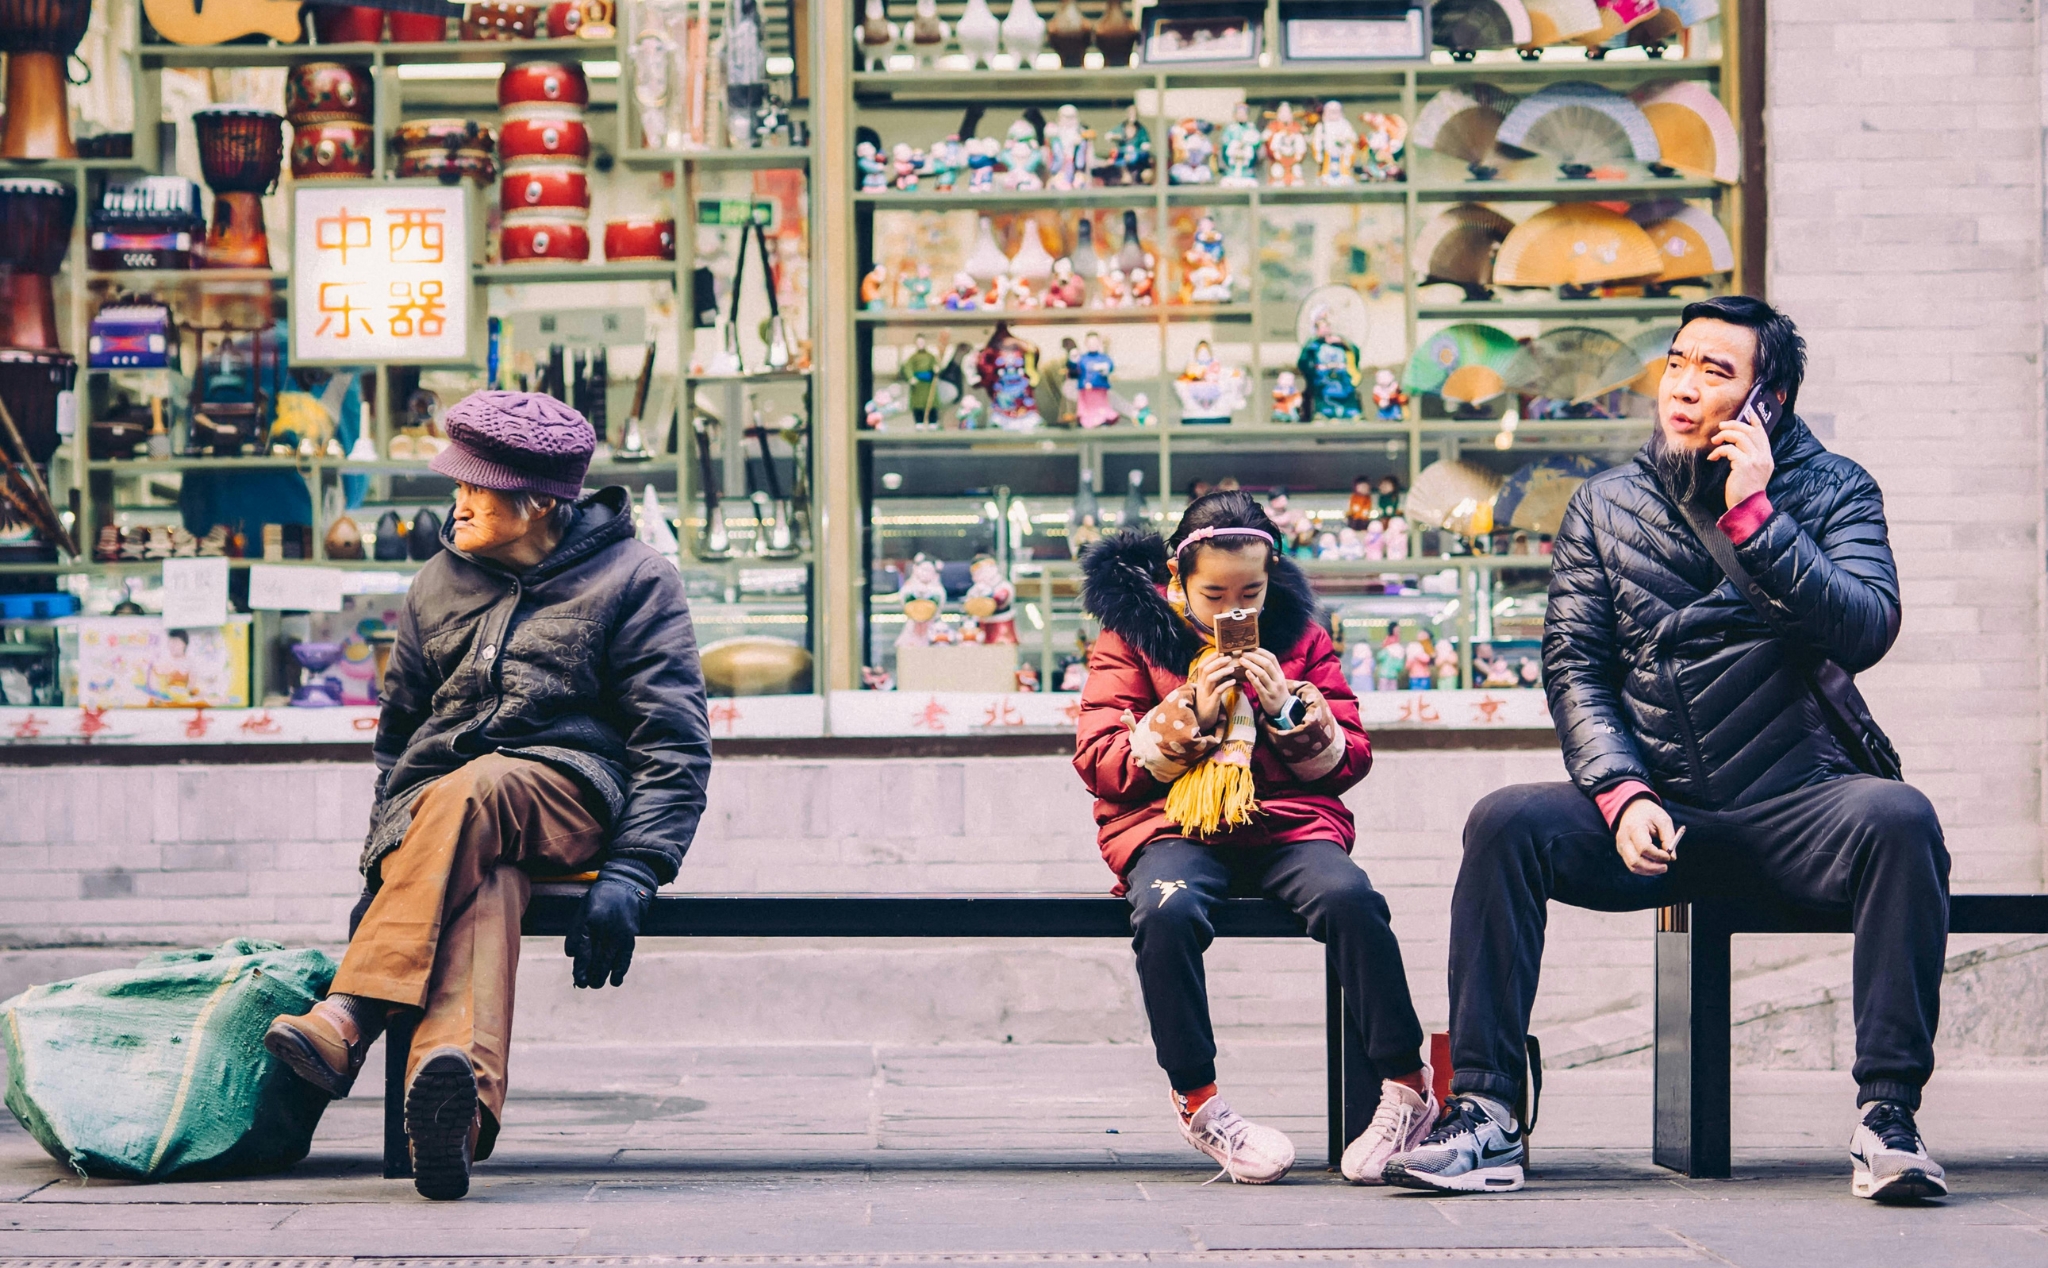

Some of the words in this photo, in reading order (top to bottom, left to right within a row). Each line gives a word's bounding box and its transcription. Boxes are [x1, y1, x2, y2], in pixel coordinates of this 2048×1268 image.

[315, 206, 447, 266] 中西
[315, 280, 447, 339] 乐器
[1360, 694, 1507, 723] 北京
